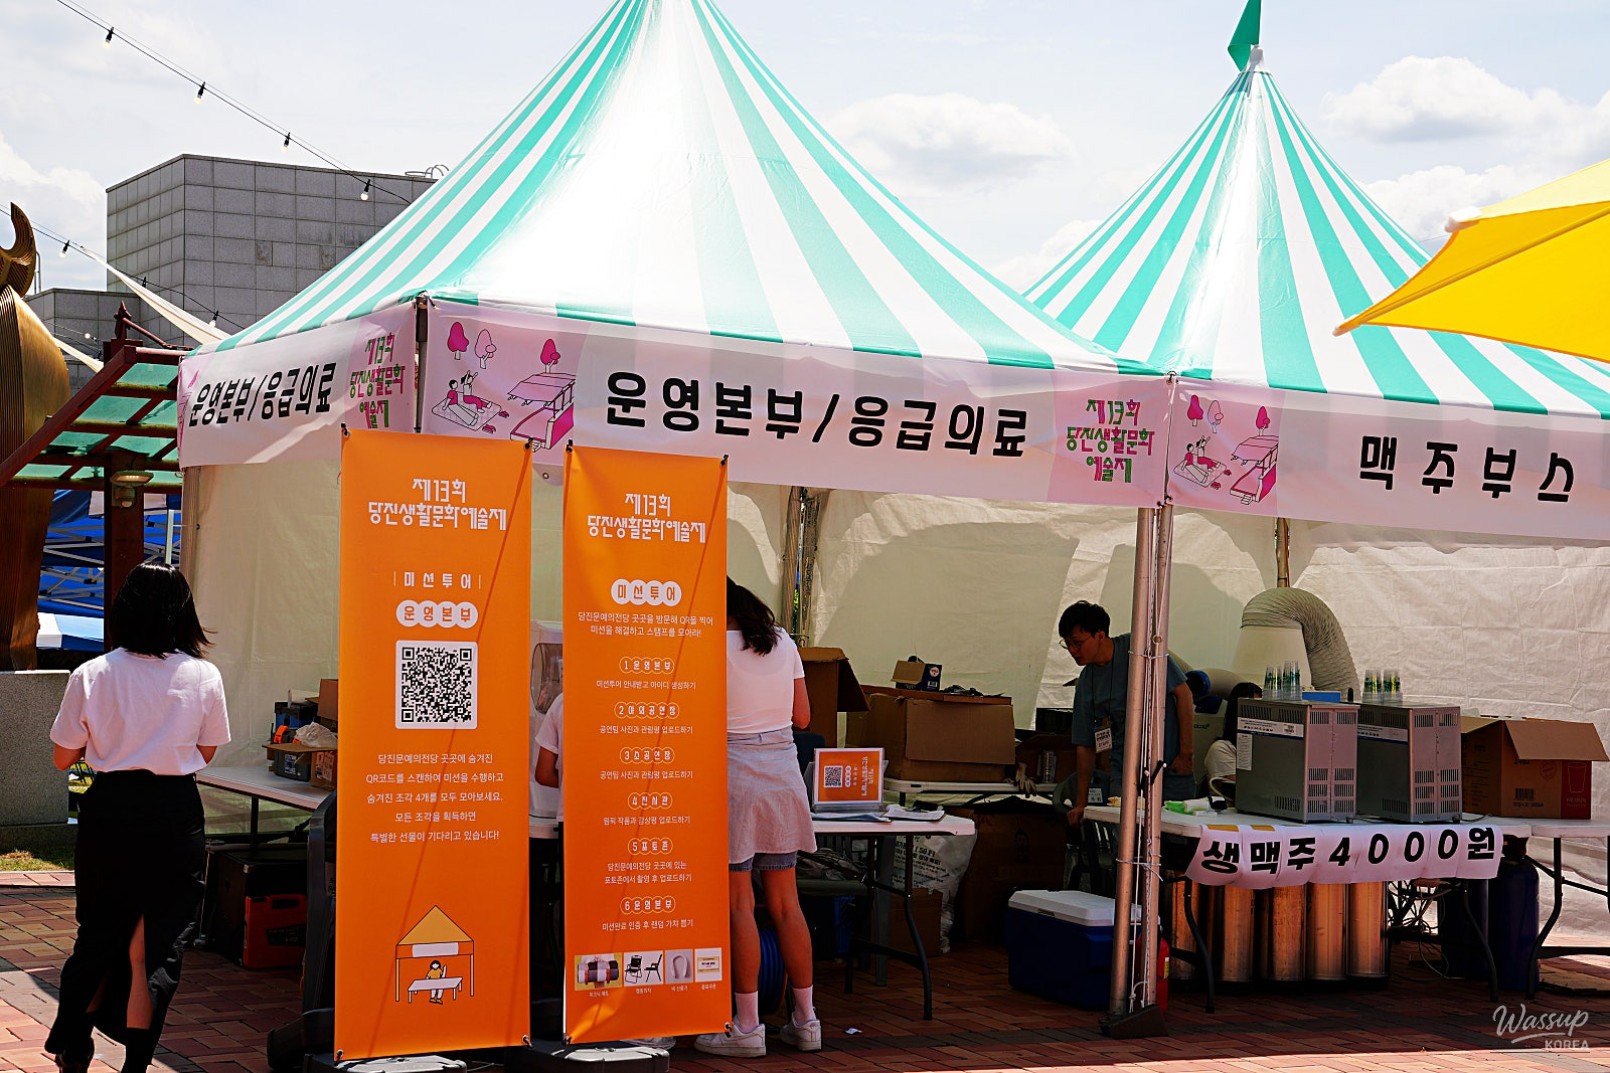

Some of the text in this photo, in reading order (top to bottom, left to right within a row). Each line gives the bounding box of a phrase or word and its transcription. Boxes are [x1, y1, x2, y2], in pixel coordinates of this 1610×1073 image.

[365, 332, 396, 365] 제13회
[350, 364, 406, 398] 당진생활문화
[189, 362, 337, 427] 운영본부/응급의료
[360, 400, 389, 429] 예술제
[606, 371, 1028, 457] 운영본부/응급의료
[1086, 399, 1140, 426] 제13회
[1066, 426, 1155, 456] 당진생활문화
[1086, 456, 1132, 483] 예술제
[412, 478, 466, 503] 제13회
[624, 493, 671, 516] 제13회
[368, 502, 506, 530] 당진생활문화예술제
[588, 515, 706, 543] 당진생활문화예술제
[404, 572, 471, 589] 미션투어
[618, 585, 675, 601] 미션투어
[404, 605, 471, 622] 운영본부
[578, 612, 630, 622] 당진문예의전당
[632, 614, 653, 624] 곳곳을
[656, 614, 678, 624] 방문해
[590, 625, 612, 636] 미션을
[614, 626, 644, 636] 해결하고
[646, 627, 675, 637] 스탬프를
[596, 680, 622, 688] 미션투어
[650, 681, 669, 689] 아이디
[672, 682, 696, 690] 생성하기
[600, 726, 618, 734] 공연팀
[620, 726, 640, 734] 사진과
[662, 726, 693, 734] 업로드하기
[378, 753, 493, 764] 당진문예의전당 곳곳에 숨겨진
[366, 772, 504, 784] QR코드를 스캔하여 미션을 수행하고
[600, 771, 618, 779] 공연팀
[620, 771, 640, 779] 사진과
[662, 770, 693, 778] 업로드하기
[367, 794, 392, 804] 숨겨진
[396, 793, 413, 803] 조각
[415, 792, 437, 803] 4개를
[440, 792, 456, 802] 모두
[395, 812, 476, 822] 모든 조각을 획득하면
[658, 816, 691, 824] 업로드하기
[370, 830, 500, 843] 특별한 선물이 기다리고 있습니다!
[608, 861, 687, 872] 당진문예의전당 곳곳에 있는
[604, 875, 636, 884] 포토존에서
[652, 875, 658, 883] 후
[660, 874, 692, 882] 업로드하기
[643, 920, 650, 928] 후
